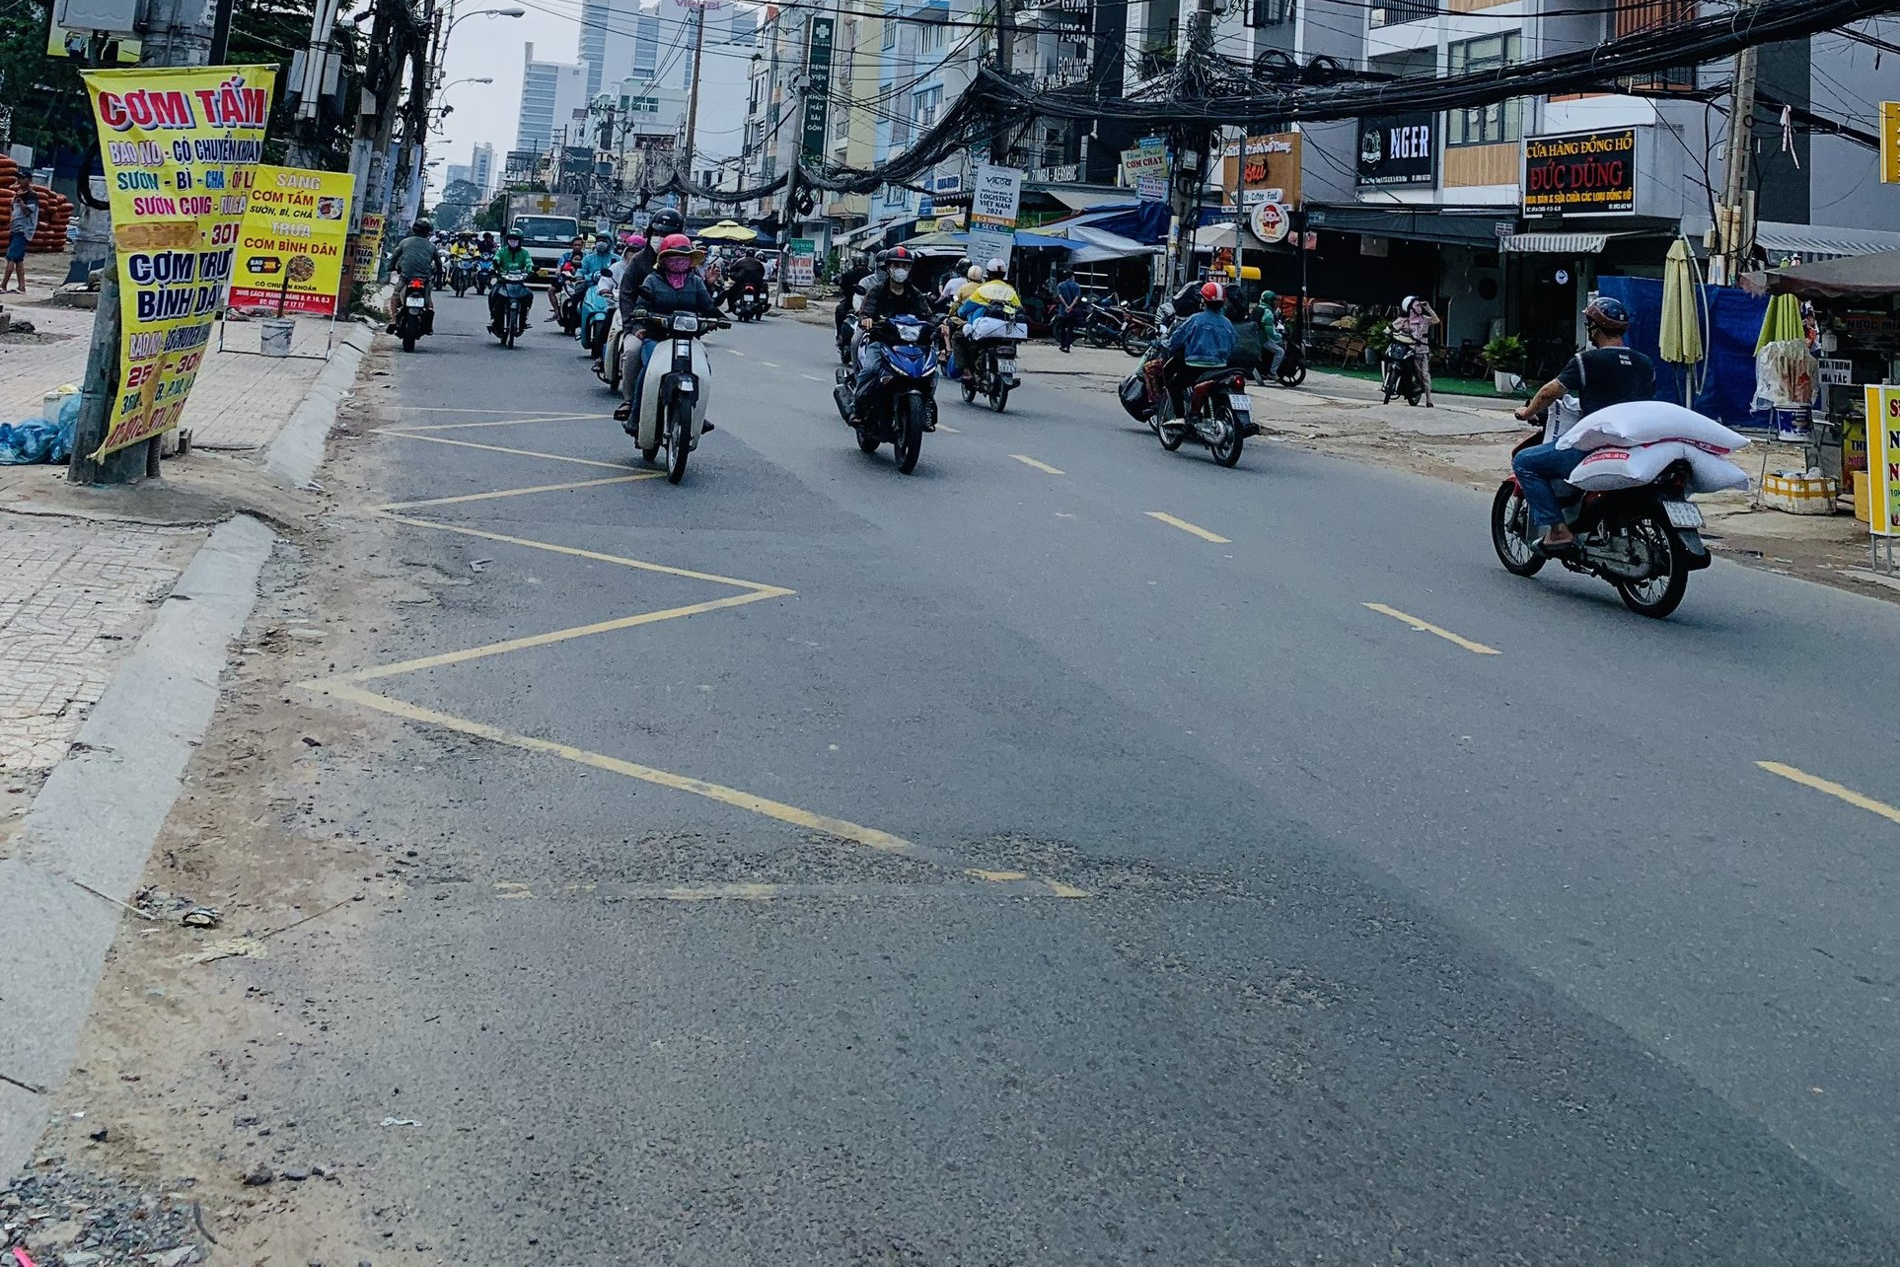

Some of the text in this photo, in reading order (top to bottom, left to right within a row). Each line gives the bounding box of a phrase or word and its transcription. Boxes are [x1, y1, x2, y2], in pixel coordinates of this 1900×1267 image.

[98, 75, 267, 131] CƠM TẤM
[1526, 131, 1633, 159] CỬA HÀNG ĐỒNG HỒ
[176, 167, 193, 190] BÌ
[276, 171, 321, 190] SÁNG
[1530, 156, 1623, 191] ĐỨC DŨNG
[252, 190, 314, 206] CƠM TẤM
[980, 192, 1012, 203] LOGISTICS
[994, 202, 1011, 210] NAM
[985, 207, 1003, 215] 2024
[271, 220, 312, 238] TRƯA
[362, 215, 380, 227] ẤM
[244, 237, 338, 256] CƠM BÌNH DÂN
[129, 247, 234, 286] CƠM TRƯ
[267, 282, 292, 290] CHUN
[137, 283, 197, 322] BÌNH
[126, 363, 156, 389] 25
